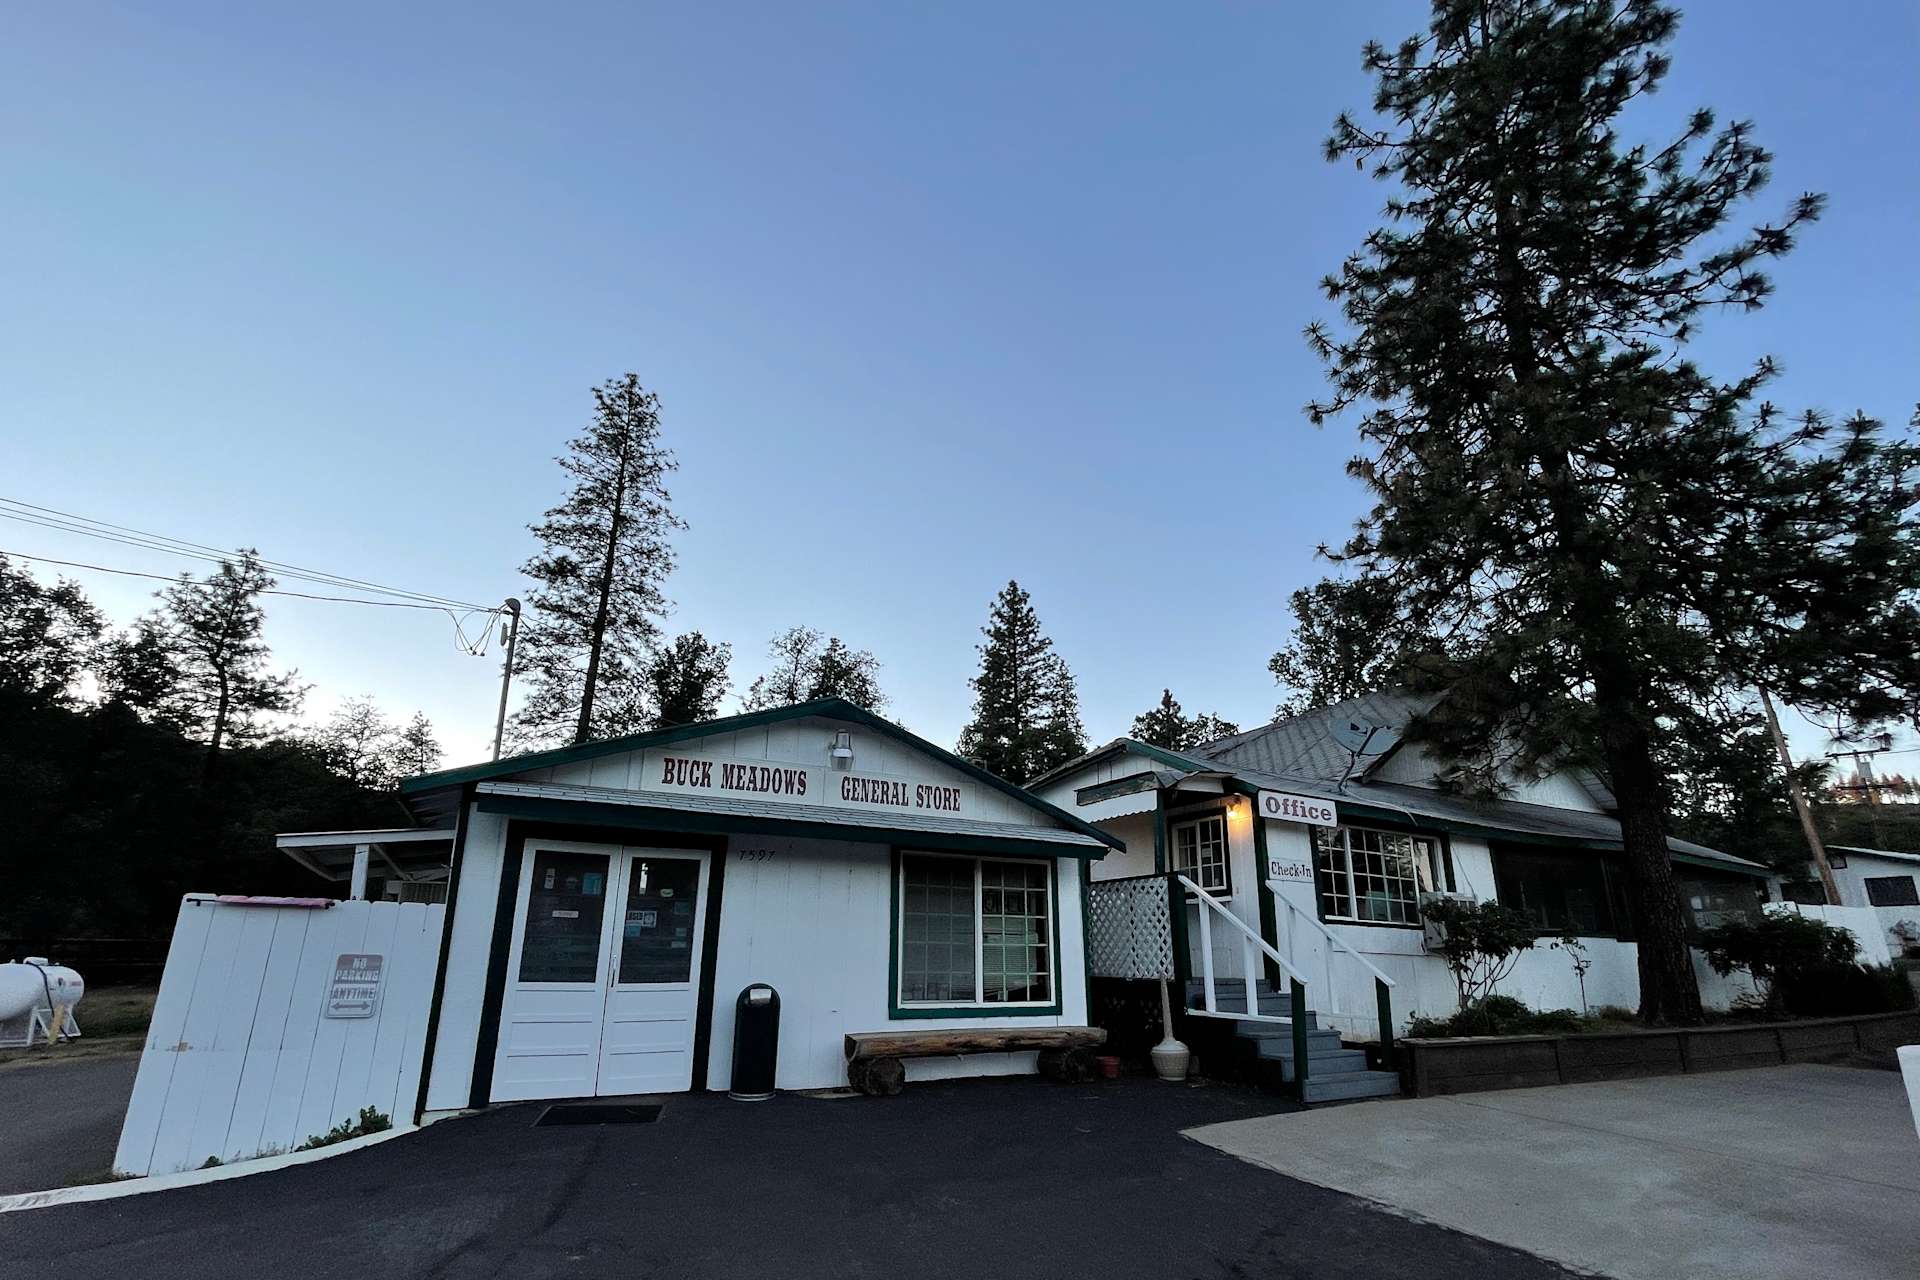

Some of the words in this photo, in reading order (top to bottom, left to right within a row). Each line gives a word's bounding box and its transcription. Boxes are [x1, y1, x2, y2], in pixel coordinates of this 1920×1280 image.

[661, 757, 713, 788] BUCK
[720, 763, 807, 796] MEADOWS
[841, 776, 909, 806] GENERAL
[916, 784, 961, 811] STORE
[1265, 796, 1332, 821] Office
[352, 957, 369, 969] NO
[335, 969, 379, 981] PARKING
[330, 987, 376, 1000] ANYTIME
